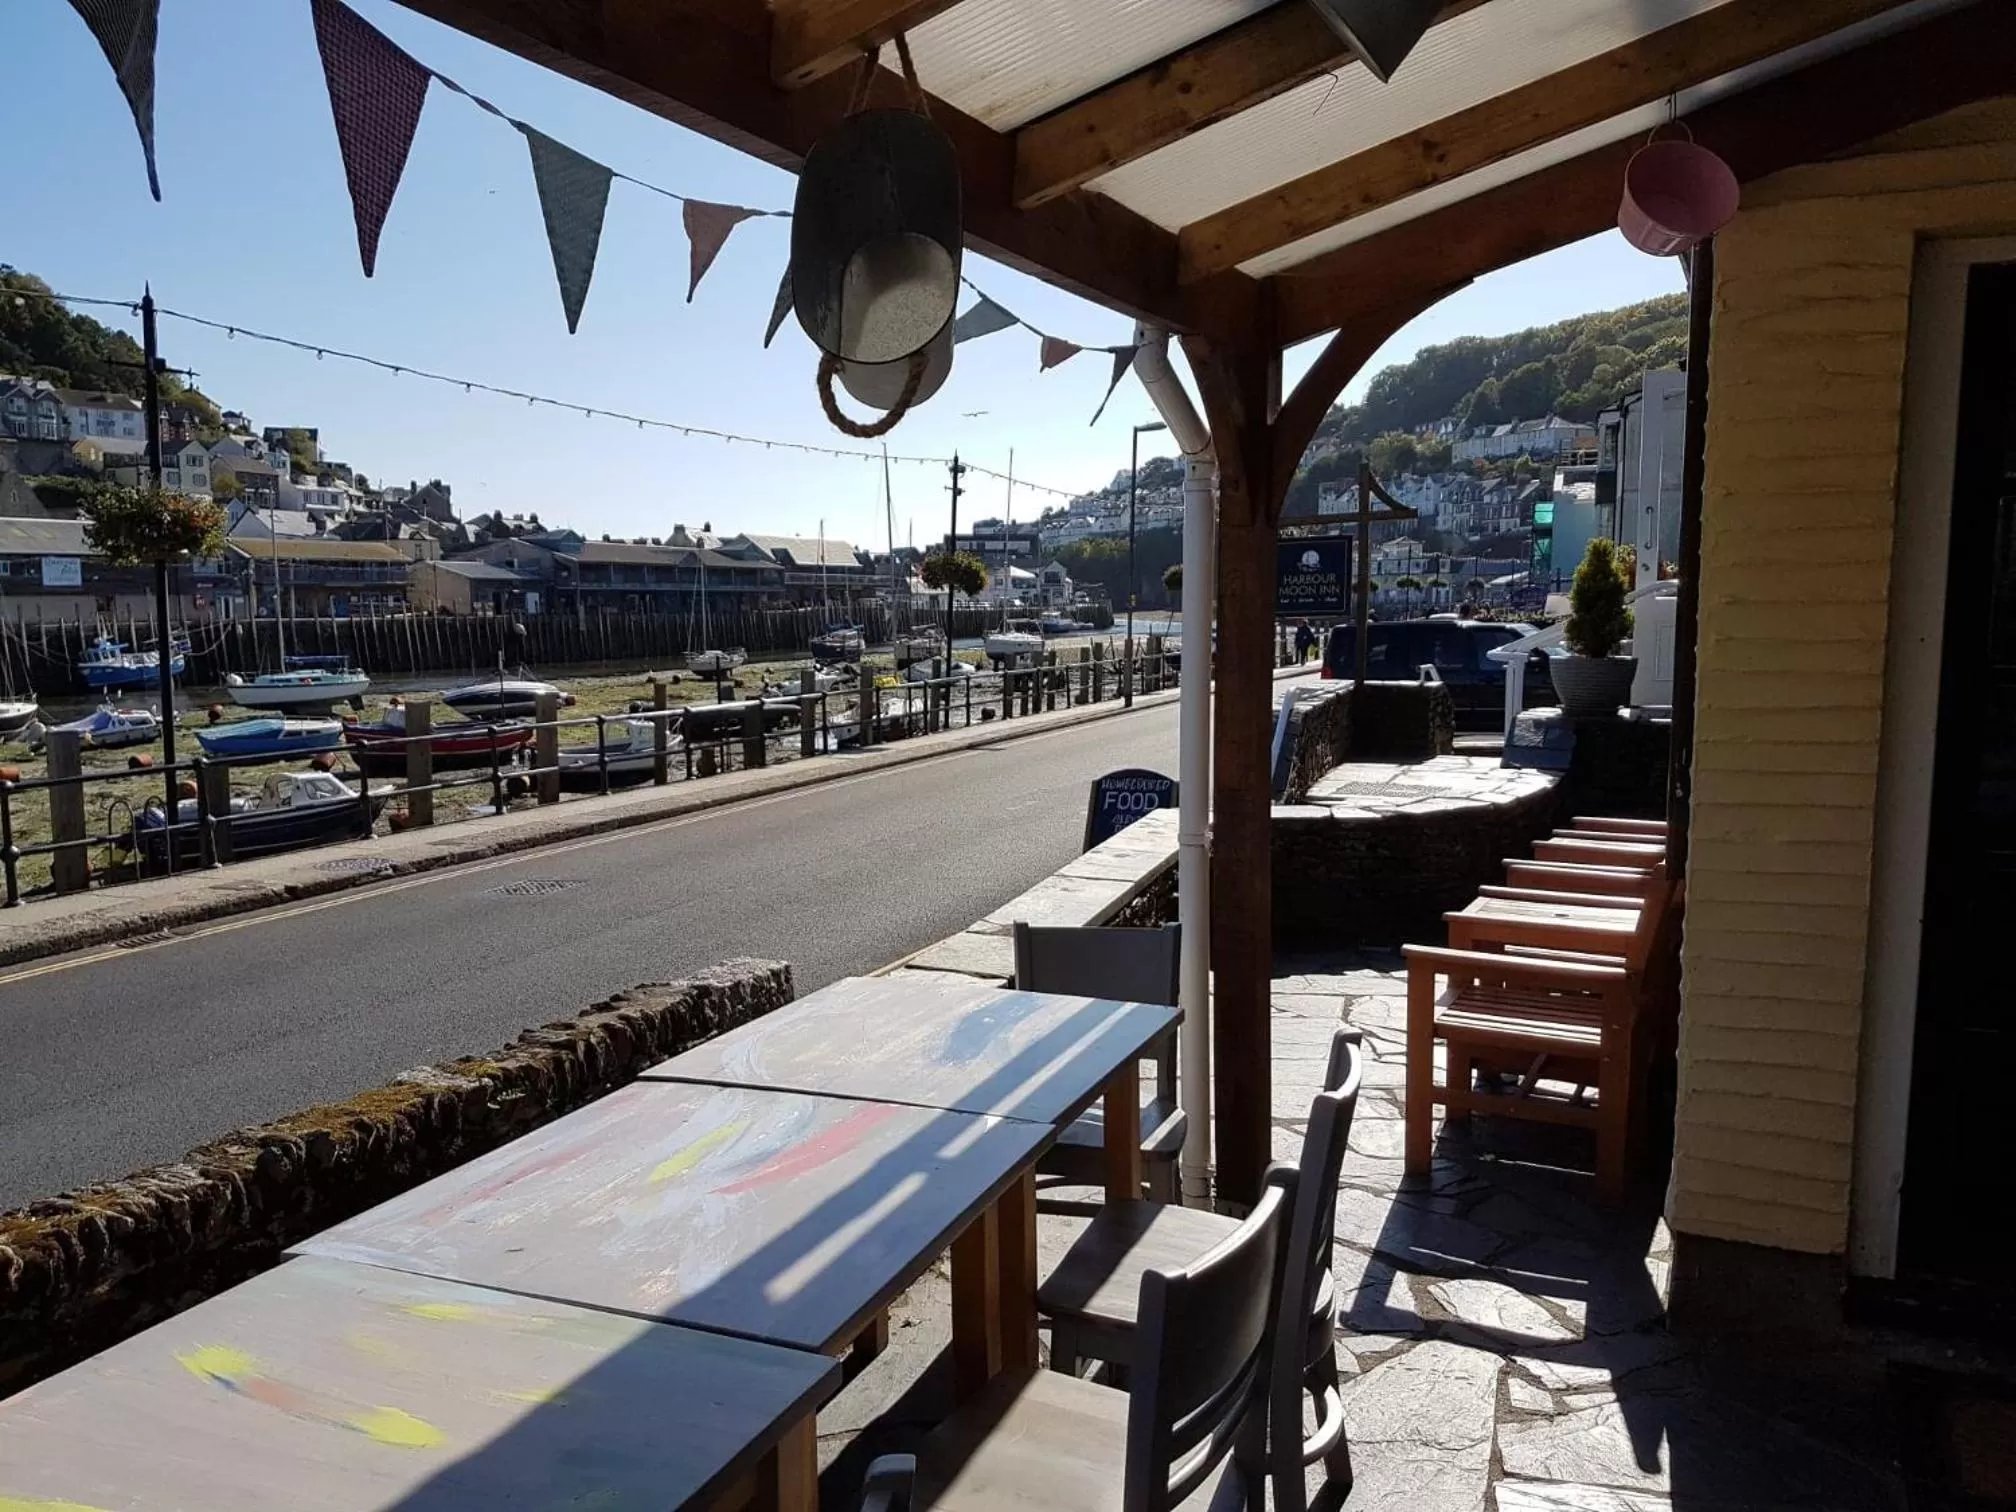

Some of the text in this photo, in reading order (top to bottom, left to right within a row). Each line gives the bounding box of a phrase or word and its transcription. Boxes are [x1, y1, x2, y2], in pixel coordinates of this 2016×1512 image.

[1284, 573, 1336, 586] HARBOUR
[1279, 585, 1341, 597] MOON INN
[1103, 792, 1158, 811] FOOD
